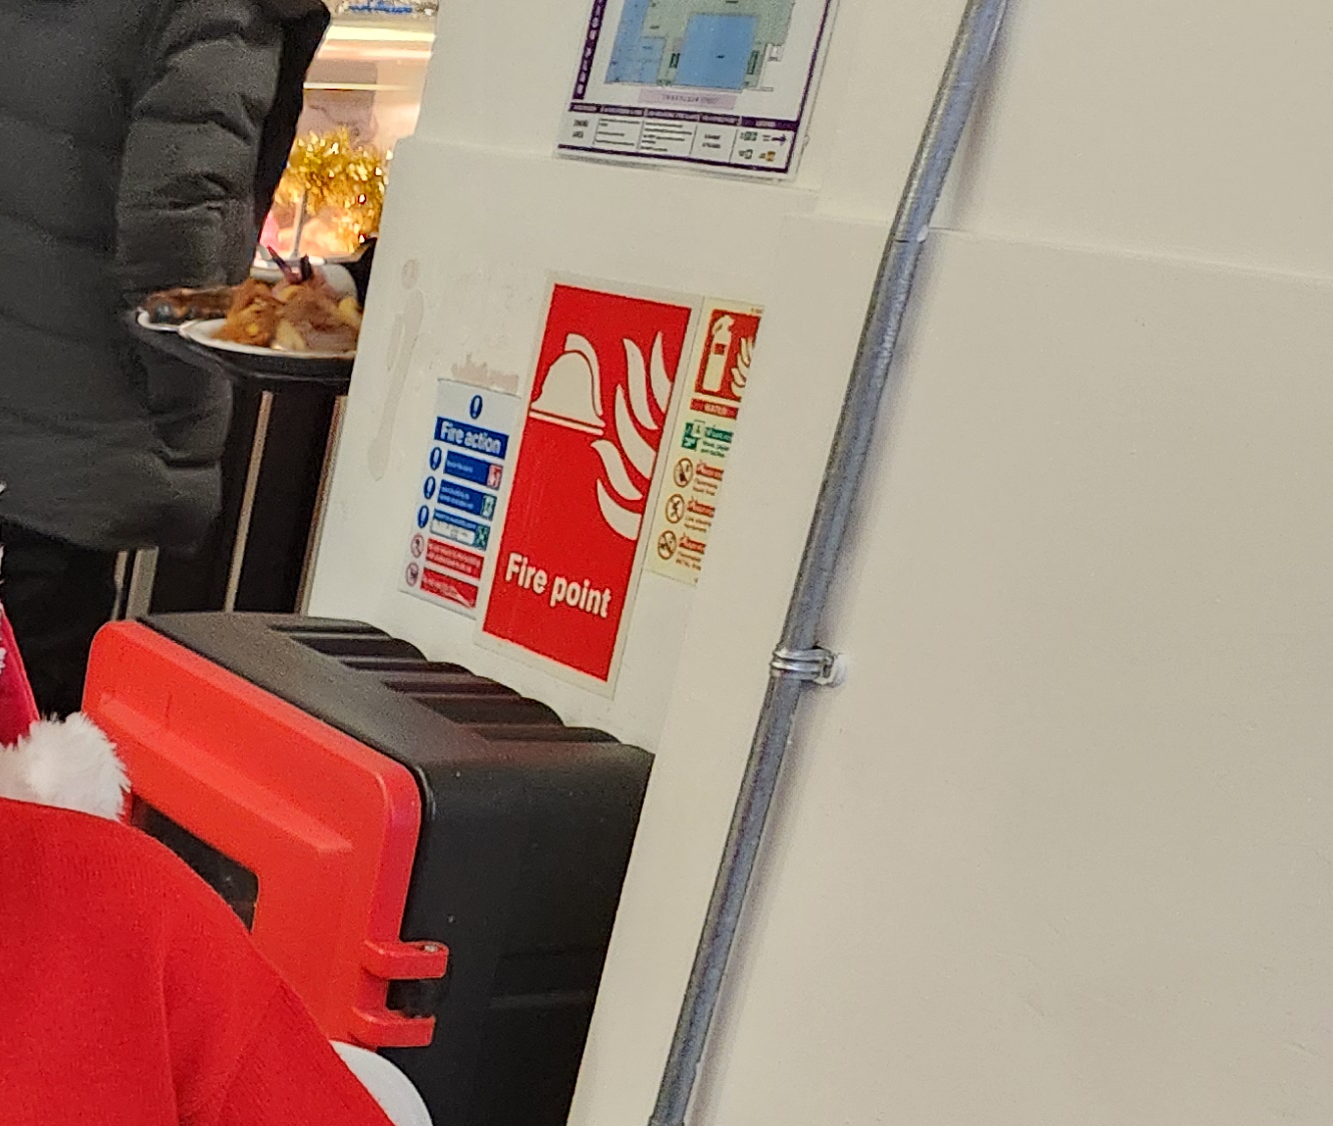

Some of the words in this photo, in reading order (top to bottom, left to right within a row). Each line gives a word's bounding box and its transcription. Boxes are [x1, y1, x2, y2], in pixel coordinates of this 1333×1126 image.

[439, 420, 464, 444] Fire
[464, 429, 502, 455] action
[504, 552, 548, 595] Fire
[550, 577, 613, 619] point
